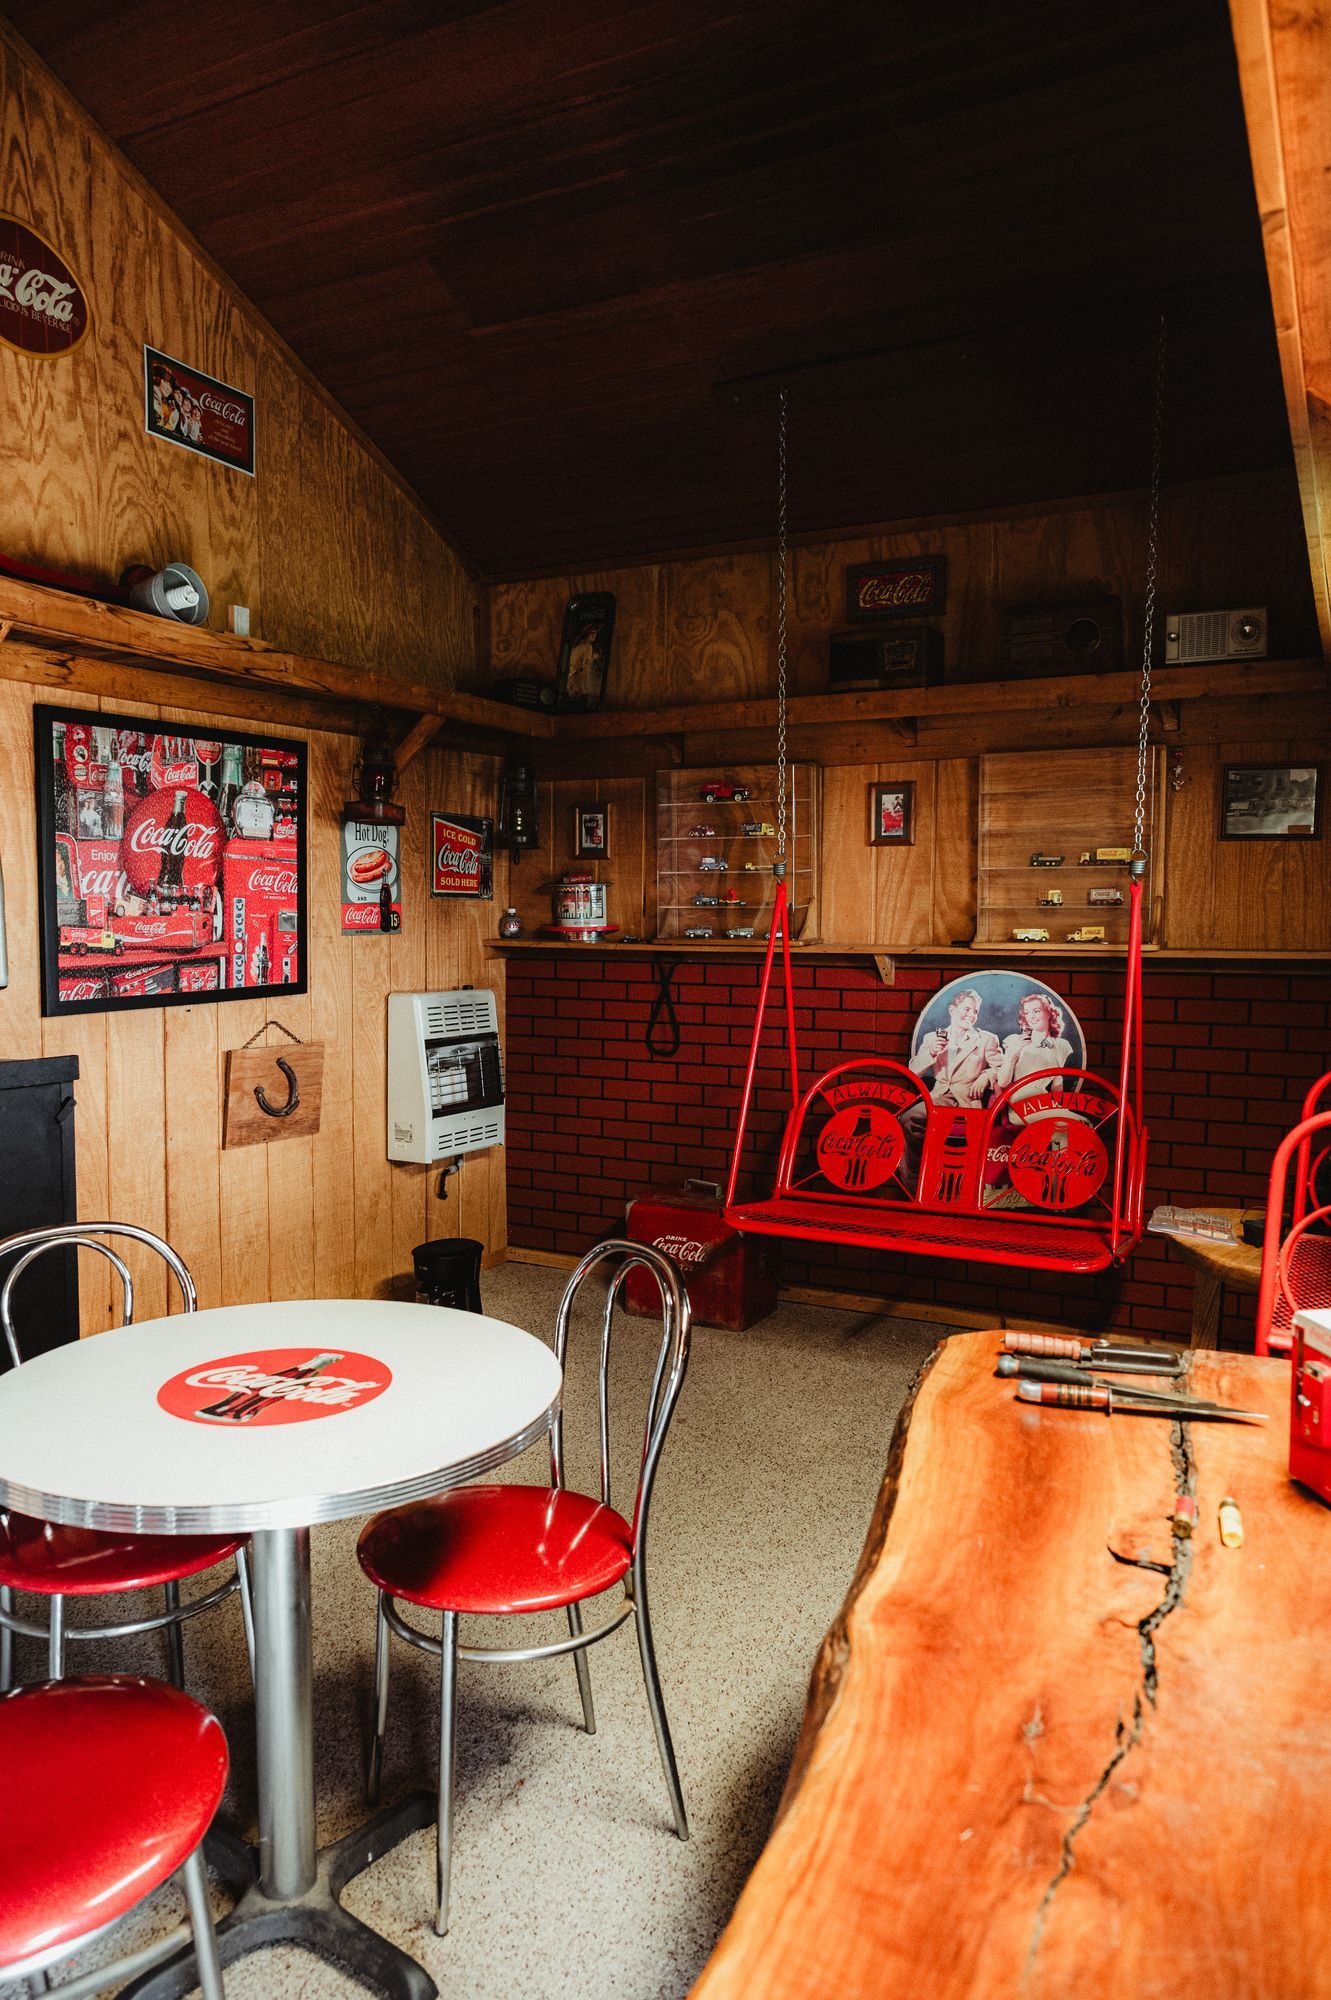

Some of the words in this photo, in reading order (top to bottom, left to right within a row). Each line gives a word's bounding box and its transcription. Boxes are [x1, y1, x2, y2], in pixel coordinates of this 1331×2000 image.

[0, 251, 26, 270] RINK
[200, 392, 246, 426] Coca-Cola
[130, 818, 220, 858] Coca-Cola
[355, 822, 369, 841] Hot
[443, 829, 456, 840] ICE
[458, 833, 477, 846] COLD
[91, 849, 118, 862] Enjoy
[438, 842, 480, 876] Coca-Cola
[440, 876, 461, 886] SOLD
[461, 878, 478, 888] HERE
[345, 906, 380, 925] Coca-Cola
[832, 1082, 907, 1105] ALWAYS
[1021, 1096, 1107, 1117] ALWAYS
[819, 1131, 898, 1160] Coca-Cola
[1011, 1144, 1101, 1177] Coca-Cola
[664, 1234, 688, 1242] DRINK
[184, 1365, 383, 1406] Coca-Cola
